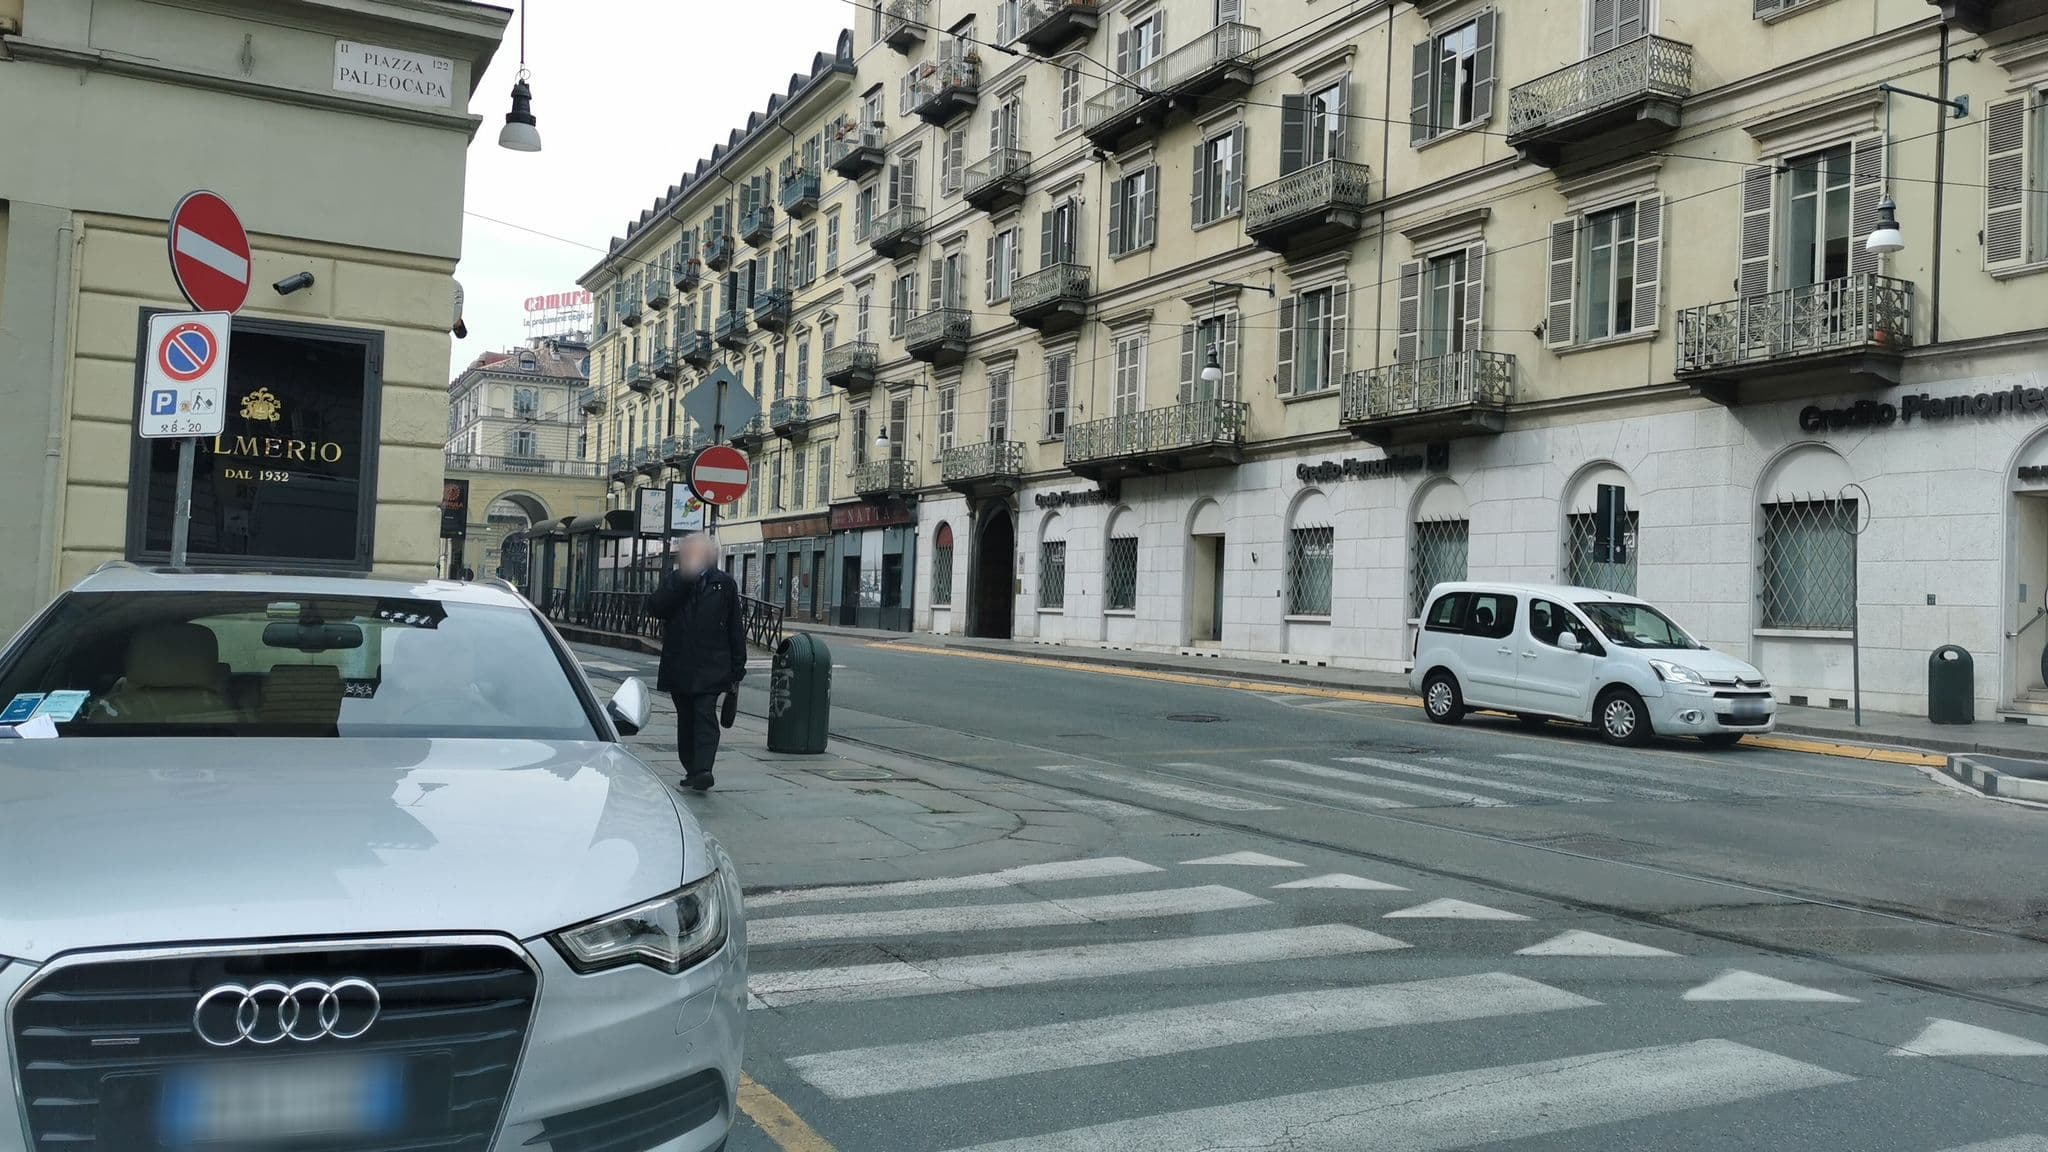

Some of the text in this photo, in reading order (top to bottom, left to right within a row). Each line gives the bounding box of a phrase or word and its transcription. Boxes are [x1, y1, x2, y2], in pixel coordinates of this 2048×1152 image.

[365, 53, 424, 75] PIAZZA
[433, 60, 449, 71] 122
[340, 67, 447, 98] PALEOCAPA
[1799, 399, 1897, 431] Credito
[171, 424, 178, 433] 8
[189, 423, 202, 432] 20
[225, 468, 289, 482] DAL 1932
[847, 504, 890, 523] NATTA
